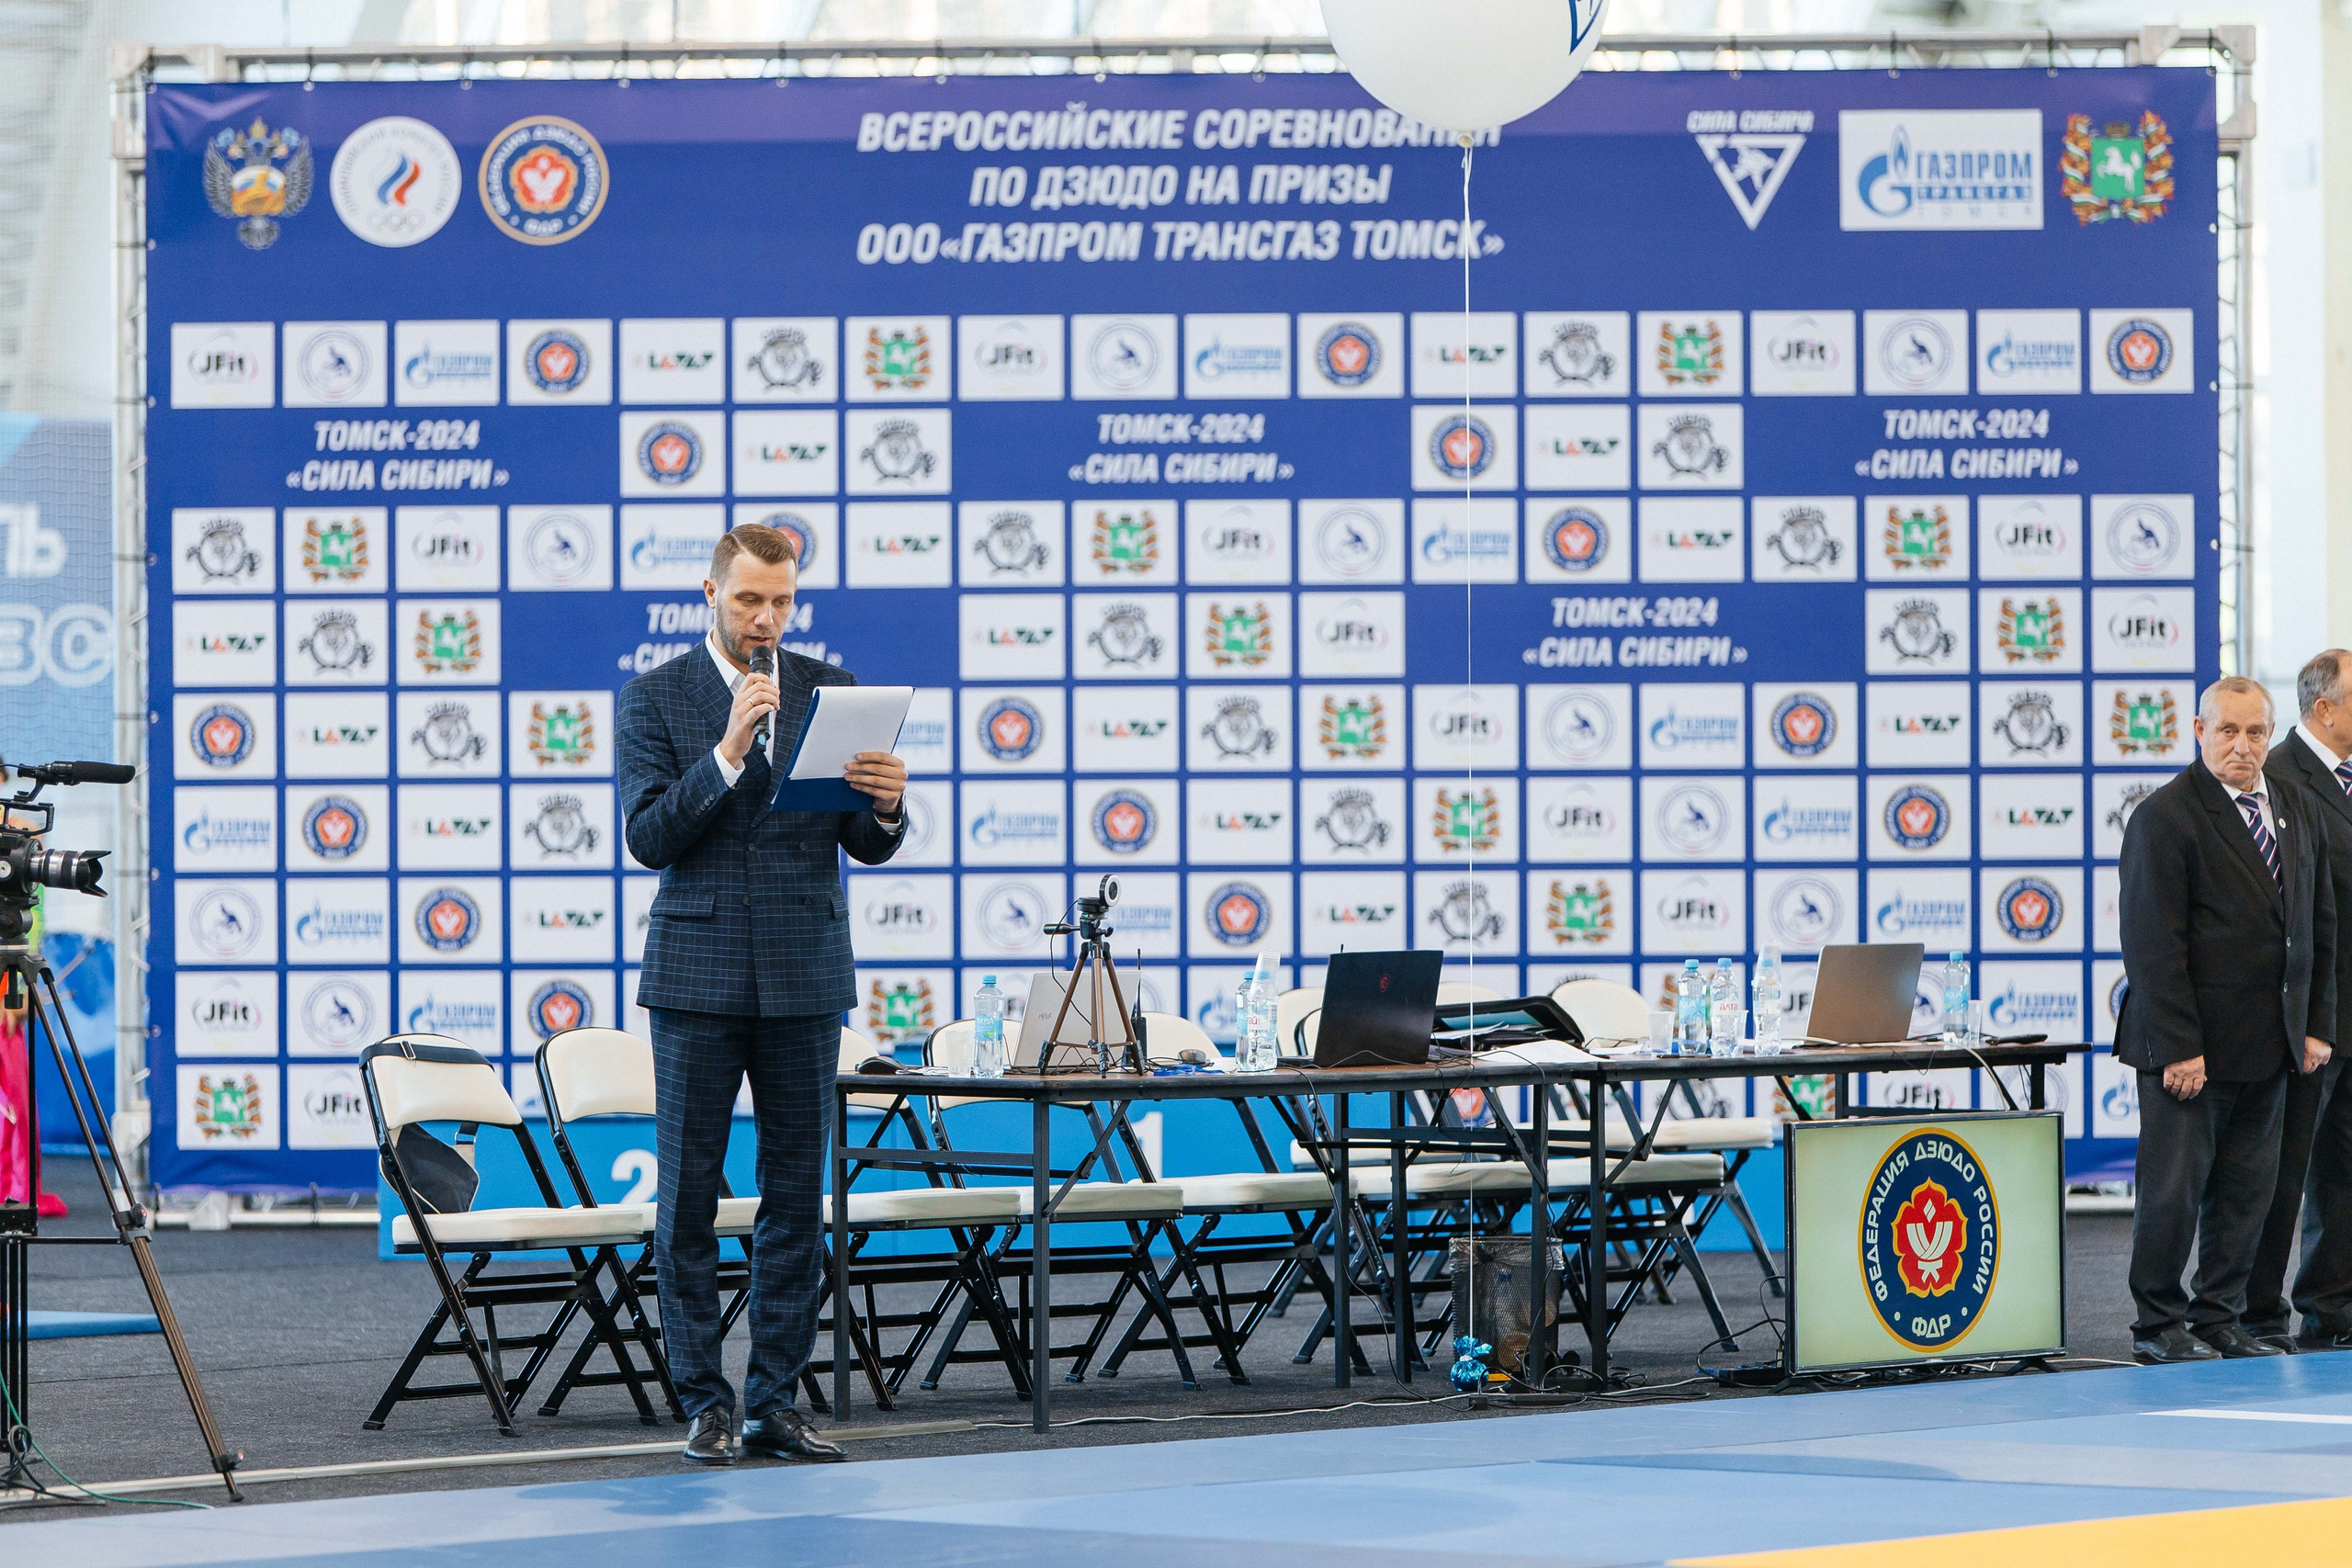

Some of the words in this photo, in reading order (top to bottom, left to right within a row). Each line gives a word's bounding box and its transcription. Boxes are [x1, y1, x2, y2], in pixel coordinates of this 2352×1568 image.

[857, 101, 1186, 152] ВСЕРОССИЙСКИЕ
[1917, 152, 2033, 179] ГАЗПРОМ
[968, 165, 1028, 208] ПО
[1030, 164, 1179, 211] ДЗЮДО
[1185, 165, 1240, 205] НА
[1248, 164, 1393, 205] ПРИЗЫ
[1151, 220, 1341, 262] ТРАНСГАЗ
[198, 353, 247, 375] JFit
[1778, 340, 1827, 362] JFit
[315, 420, 481, 452] ТОМСК-2024
[1098, 413, 1265, 445] ТОМСК-2024
[1884, 409, 2050, 440] ТОМСК-2024
[423, 536, 472, 558] JFit
[2005, 525, 2054, 547] JFit
[1552, 597, 1719, 628] ТОМСК-2024
[2119, 617, 2166, 638] JFit
[202, 1001, 251, 1023] JFit
[315, 1093, 363, 1115] JFit
[612, 1148, 658, 1203] 2
[1866, 1150, 1910, 1302] ФЕДЕРАЦИЯ
[1914, 1140, 1976, 1183] ДЗЮДО
[1973, 1185, 1994, 1295] РОССИИ
[1912, 1314, 1951, 1338] ФДР
